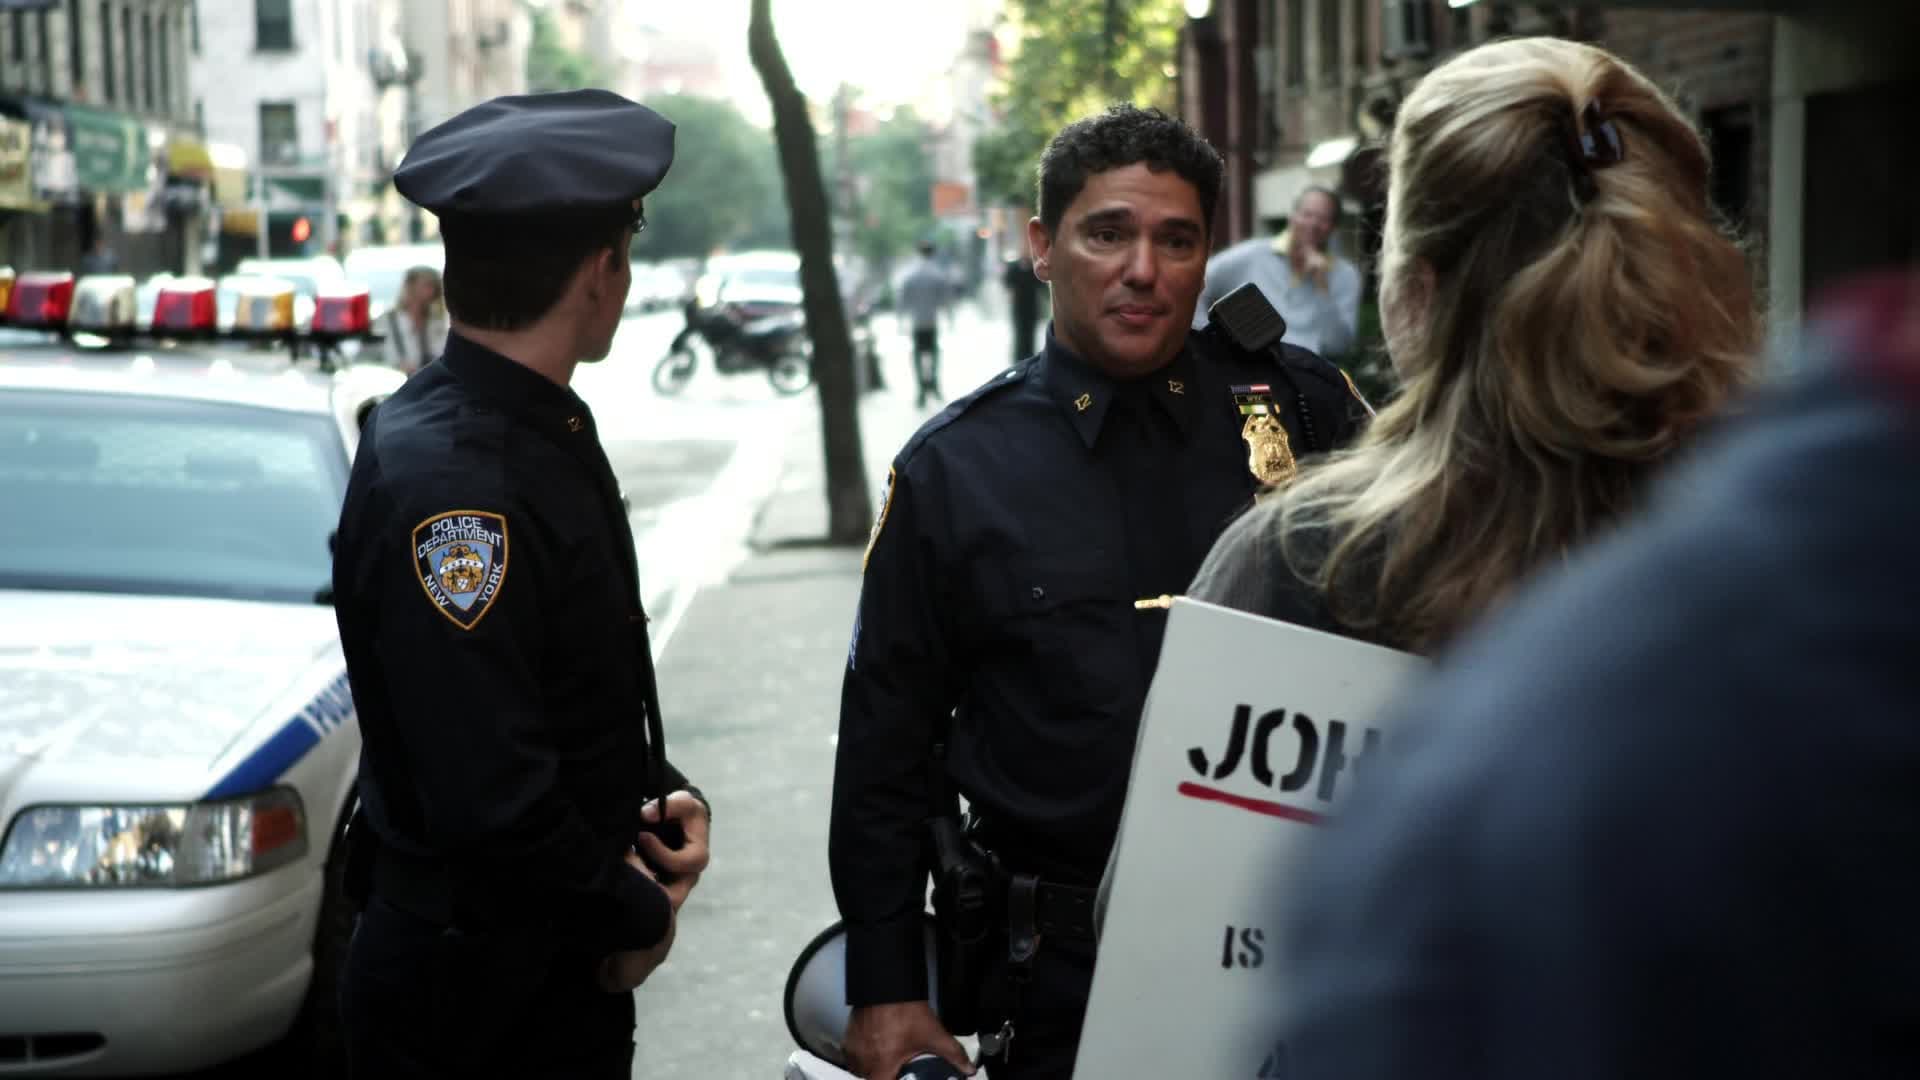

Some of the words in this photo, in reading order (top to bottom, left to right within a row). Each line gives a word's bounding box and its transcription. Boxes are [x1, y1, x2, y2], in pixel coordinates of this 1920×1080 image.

[1074, 393, 1092, 411] 12
[431, 516, 482, 537] POLICE
[417, 528, 503, 559] DEPARTMENT
[424, 574, 450, 607] NEW
[478, 563, 503, 602] YORK
[1221, 925, 1265, 970] IS
